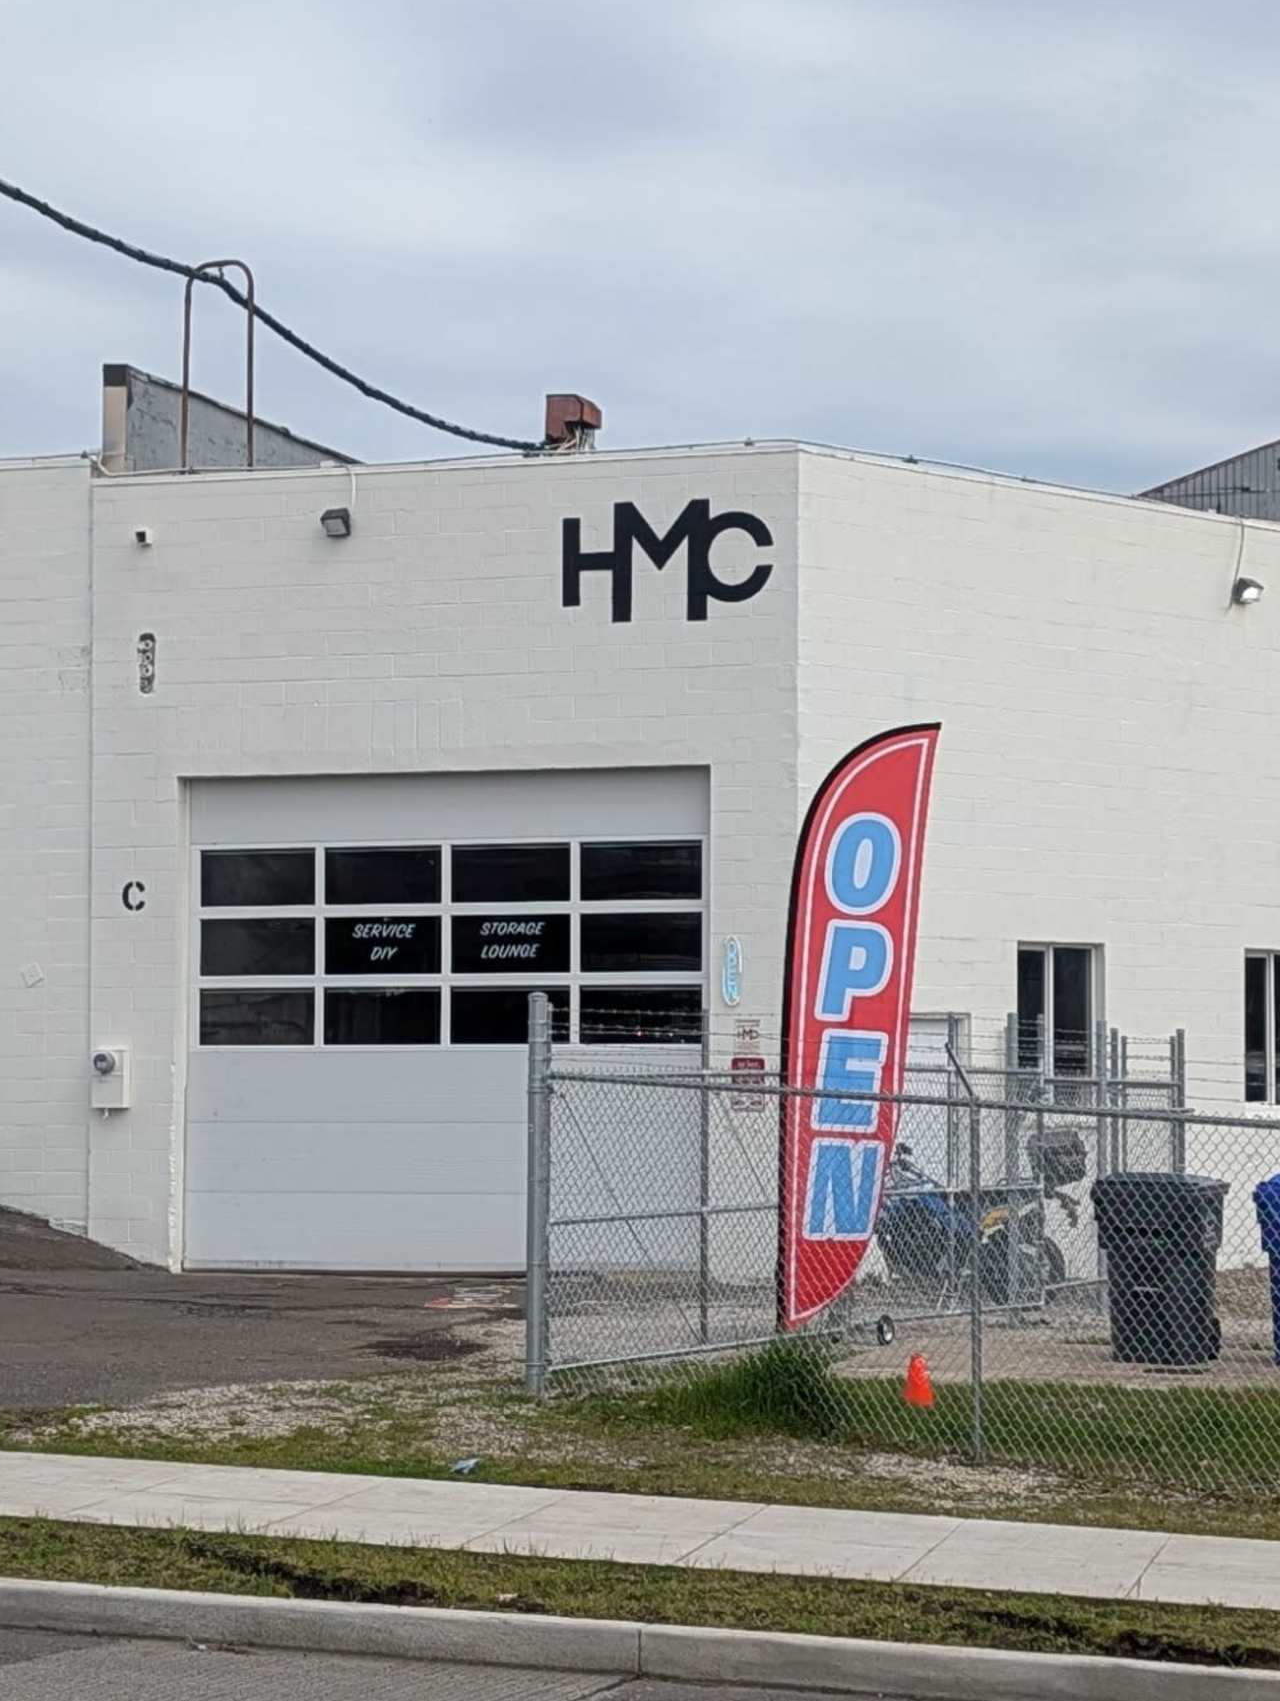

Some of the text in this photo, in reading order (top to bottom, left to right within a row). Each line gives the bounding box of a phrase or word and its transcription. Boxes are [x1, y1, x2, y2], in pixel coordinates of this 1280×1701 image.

[562, 498, 774, 623] HMC
[122, 880, 146, 912] C
[352, 923, 416, 939] SERVICE
[480, 921, 546, 936] STORAGE
[370, 946, 399, 961] DIY
[480, 943, 541, 959] LOUNGE
[802, 811, 902, 1242] OPEN
